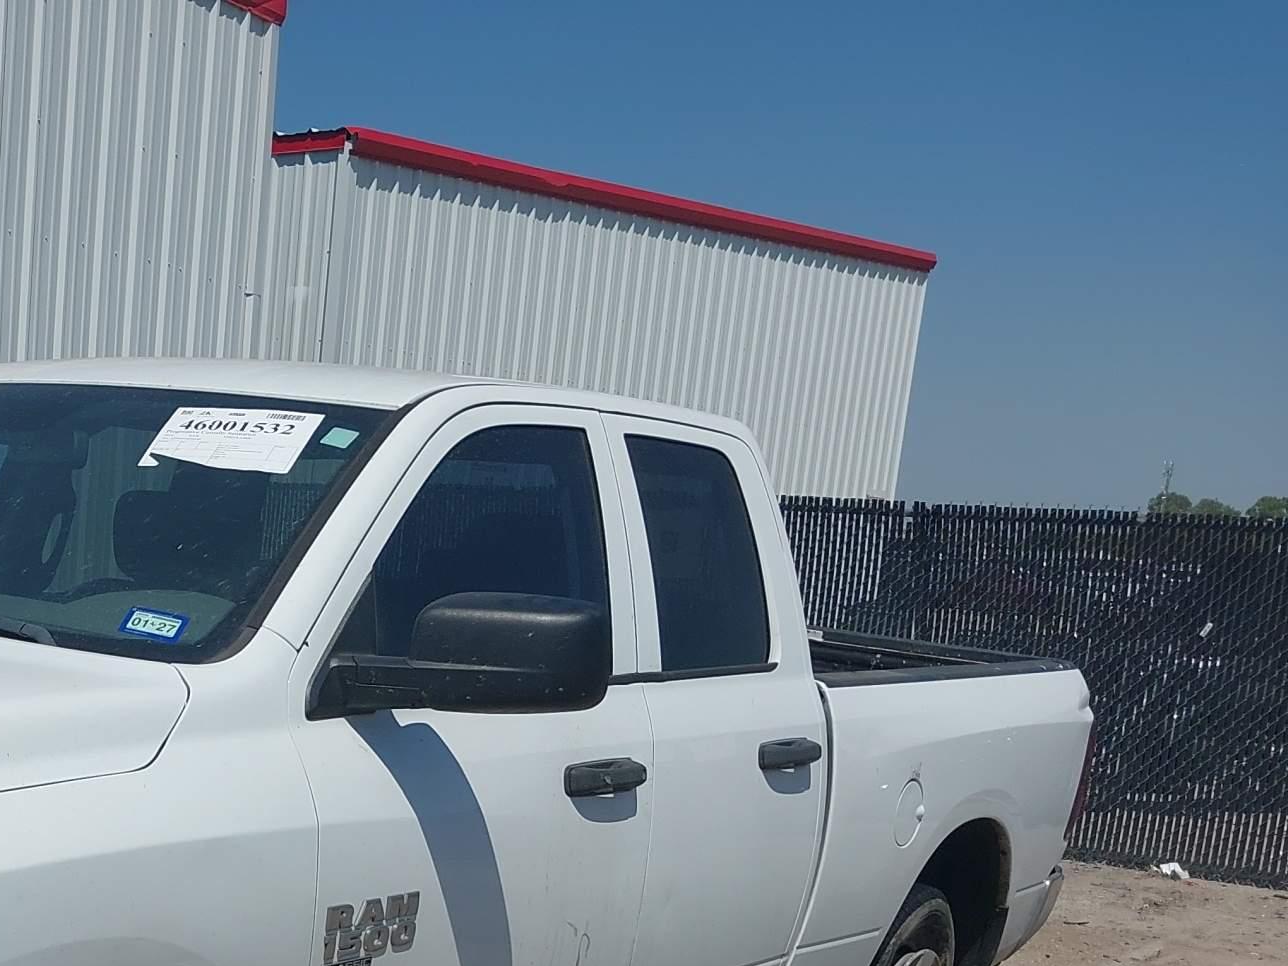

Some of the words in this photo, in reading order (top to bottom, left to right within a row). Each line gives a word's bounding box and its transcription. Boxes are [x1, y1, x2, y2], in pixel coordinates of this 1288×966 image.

[178, 419, 296, 435] 46001532
[131, 617, 149, 628] 01
[156, 622, 177, 633] 27
[325, 890, 420, 936] RAM
[323, 921, 417, 964] 1500
